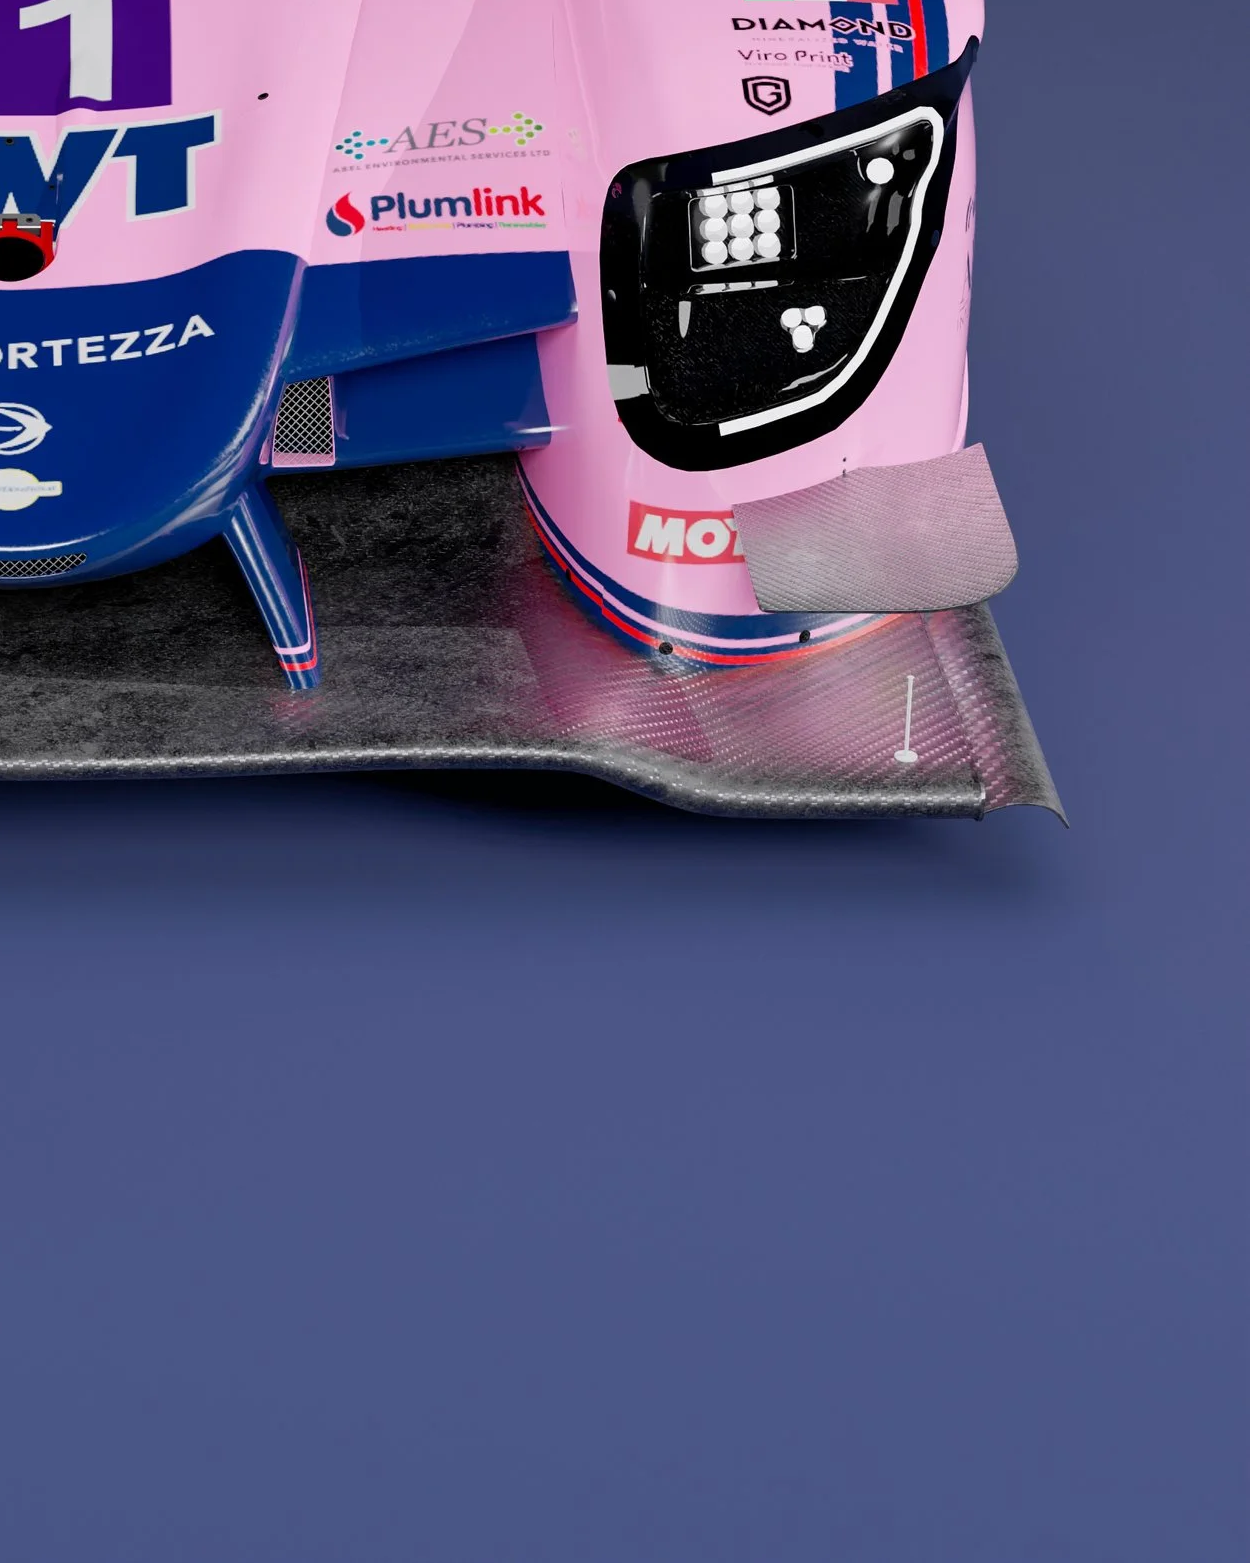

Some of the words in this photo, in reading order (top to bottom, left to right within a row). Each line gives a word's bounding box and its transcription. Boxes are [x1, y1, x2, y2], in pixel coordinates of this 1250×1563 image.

[731, 17, 914, 40] DIAMOND
[737, 49, 787, 62] Viro
[795, 50, 853, 65] Print
[382, 118, 487, 153] AES
[365, 154, 468, 170] ENVIRONMENTAL
[471, 150, 527, 160] SERVICES
[530, 149, 550, 157] LTD
[370, 185, 546, 222] Plumlink
